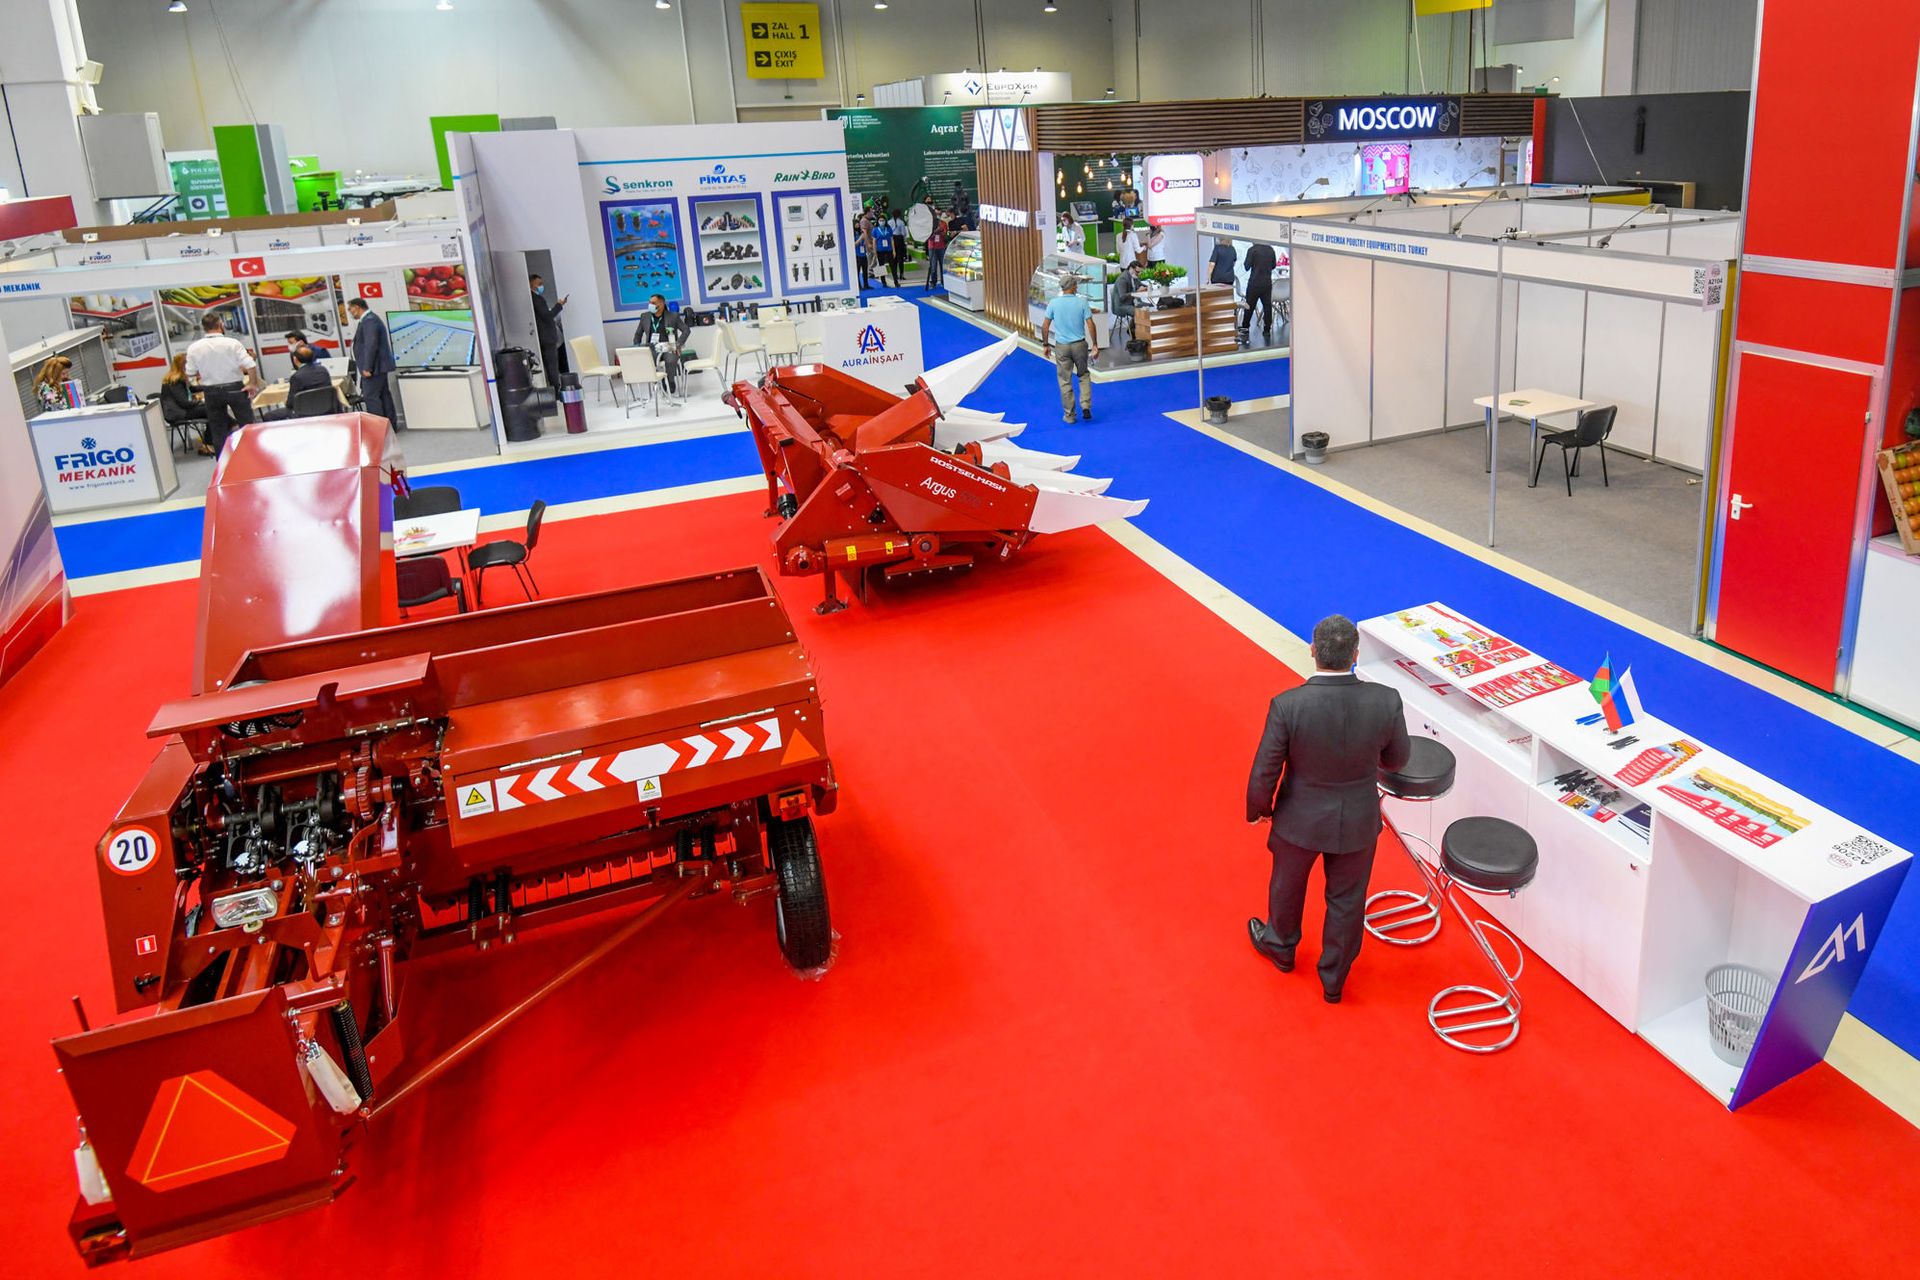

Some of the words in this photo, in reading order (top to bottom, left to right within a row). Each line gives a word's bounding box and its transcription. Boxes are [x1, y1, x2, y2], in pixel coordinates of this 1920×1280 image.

[772, 22, 789, 30] ZAL
[799, 24, 810, 39] 1
[775, 60, 794, 68] EXIT
[1338, 105, 1437, 131] MOSCOW
[930, 123, 959, 135] Aqrar
[623, 180, 673, 190] senkron
[980, 204, 997, 223] OPEN
[998, 206, 1029, 228] MOSCOW
[59, 464, 136, 483] MEKANİK
[930, 456, 1007, 493] ROSTSELMASH
[920, 476, 957, 499] Argus
[117, 835, 149, 865] 20
[1832, 844, 1870, 865] A2206
